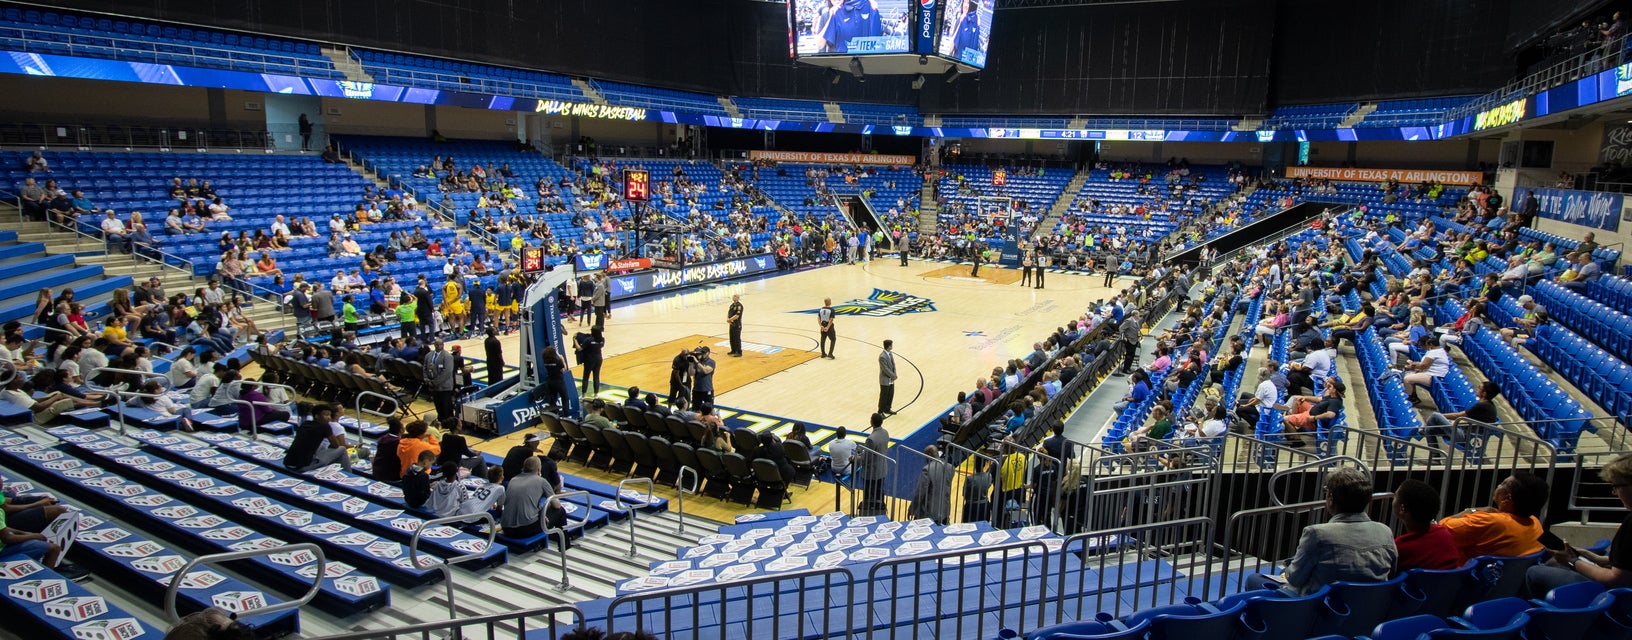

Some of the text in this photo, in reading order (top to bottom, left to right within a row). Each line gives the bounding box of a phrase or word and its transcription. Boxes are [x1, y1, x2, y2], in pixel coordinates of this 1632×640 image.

[859, 40, 876, 50] ITEM
[536, 99, 646, 121] DALLAS WINGS BASKETBALL
[759, 152, 808, 160] UNIVERSITY
[823, 153, 849, 161] TEXAS
[850, 154, 861, 162] AT
[862, 154, 907, 163] ARLINGTON
[631, 173, 647, 182] 4:21
[994, 176, 1004, 185] 24
[1294, 169, 1469, 182] UNIVERSITY OF TEXAS AT ARLINGTON
[629, 182, 645, 198] 24
[1541, 195, 1549, 212] OF
[1549, 195, 1563, 214] THE
[1588, 192, 1614, 229] Wings
[527, 259, 538, 269] 24
[652, 270, 682, 288] DALLAS
[683, 266, 706, 282] WINGS
[706, 260, 747, 278] BASKETBALL
